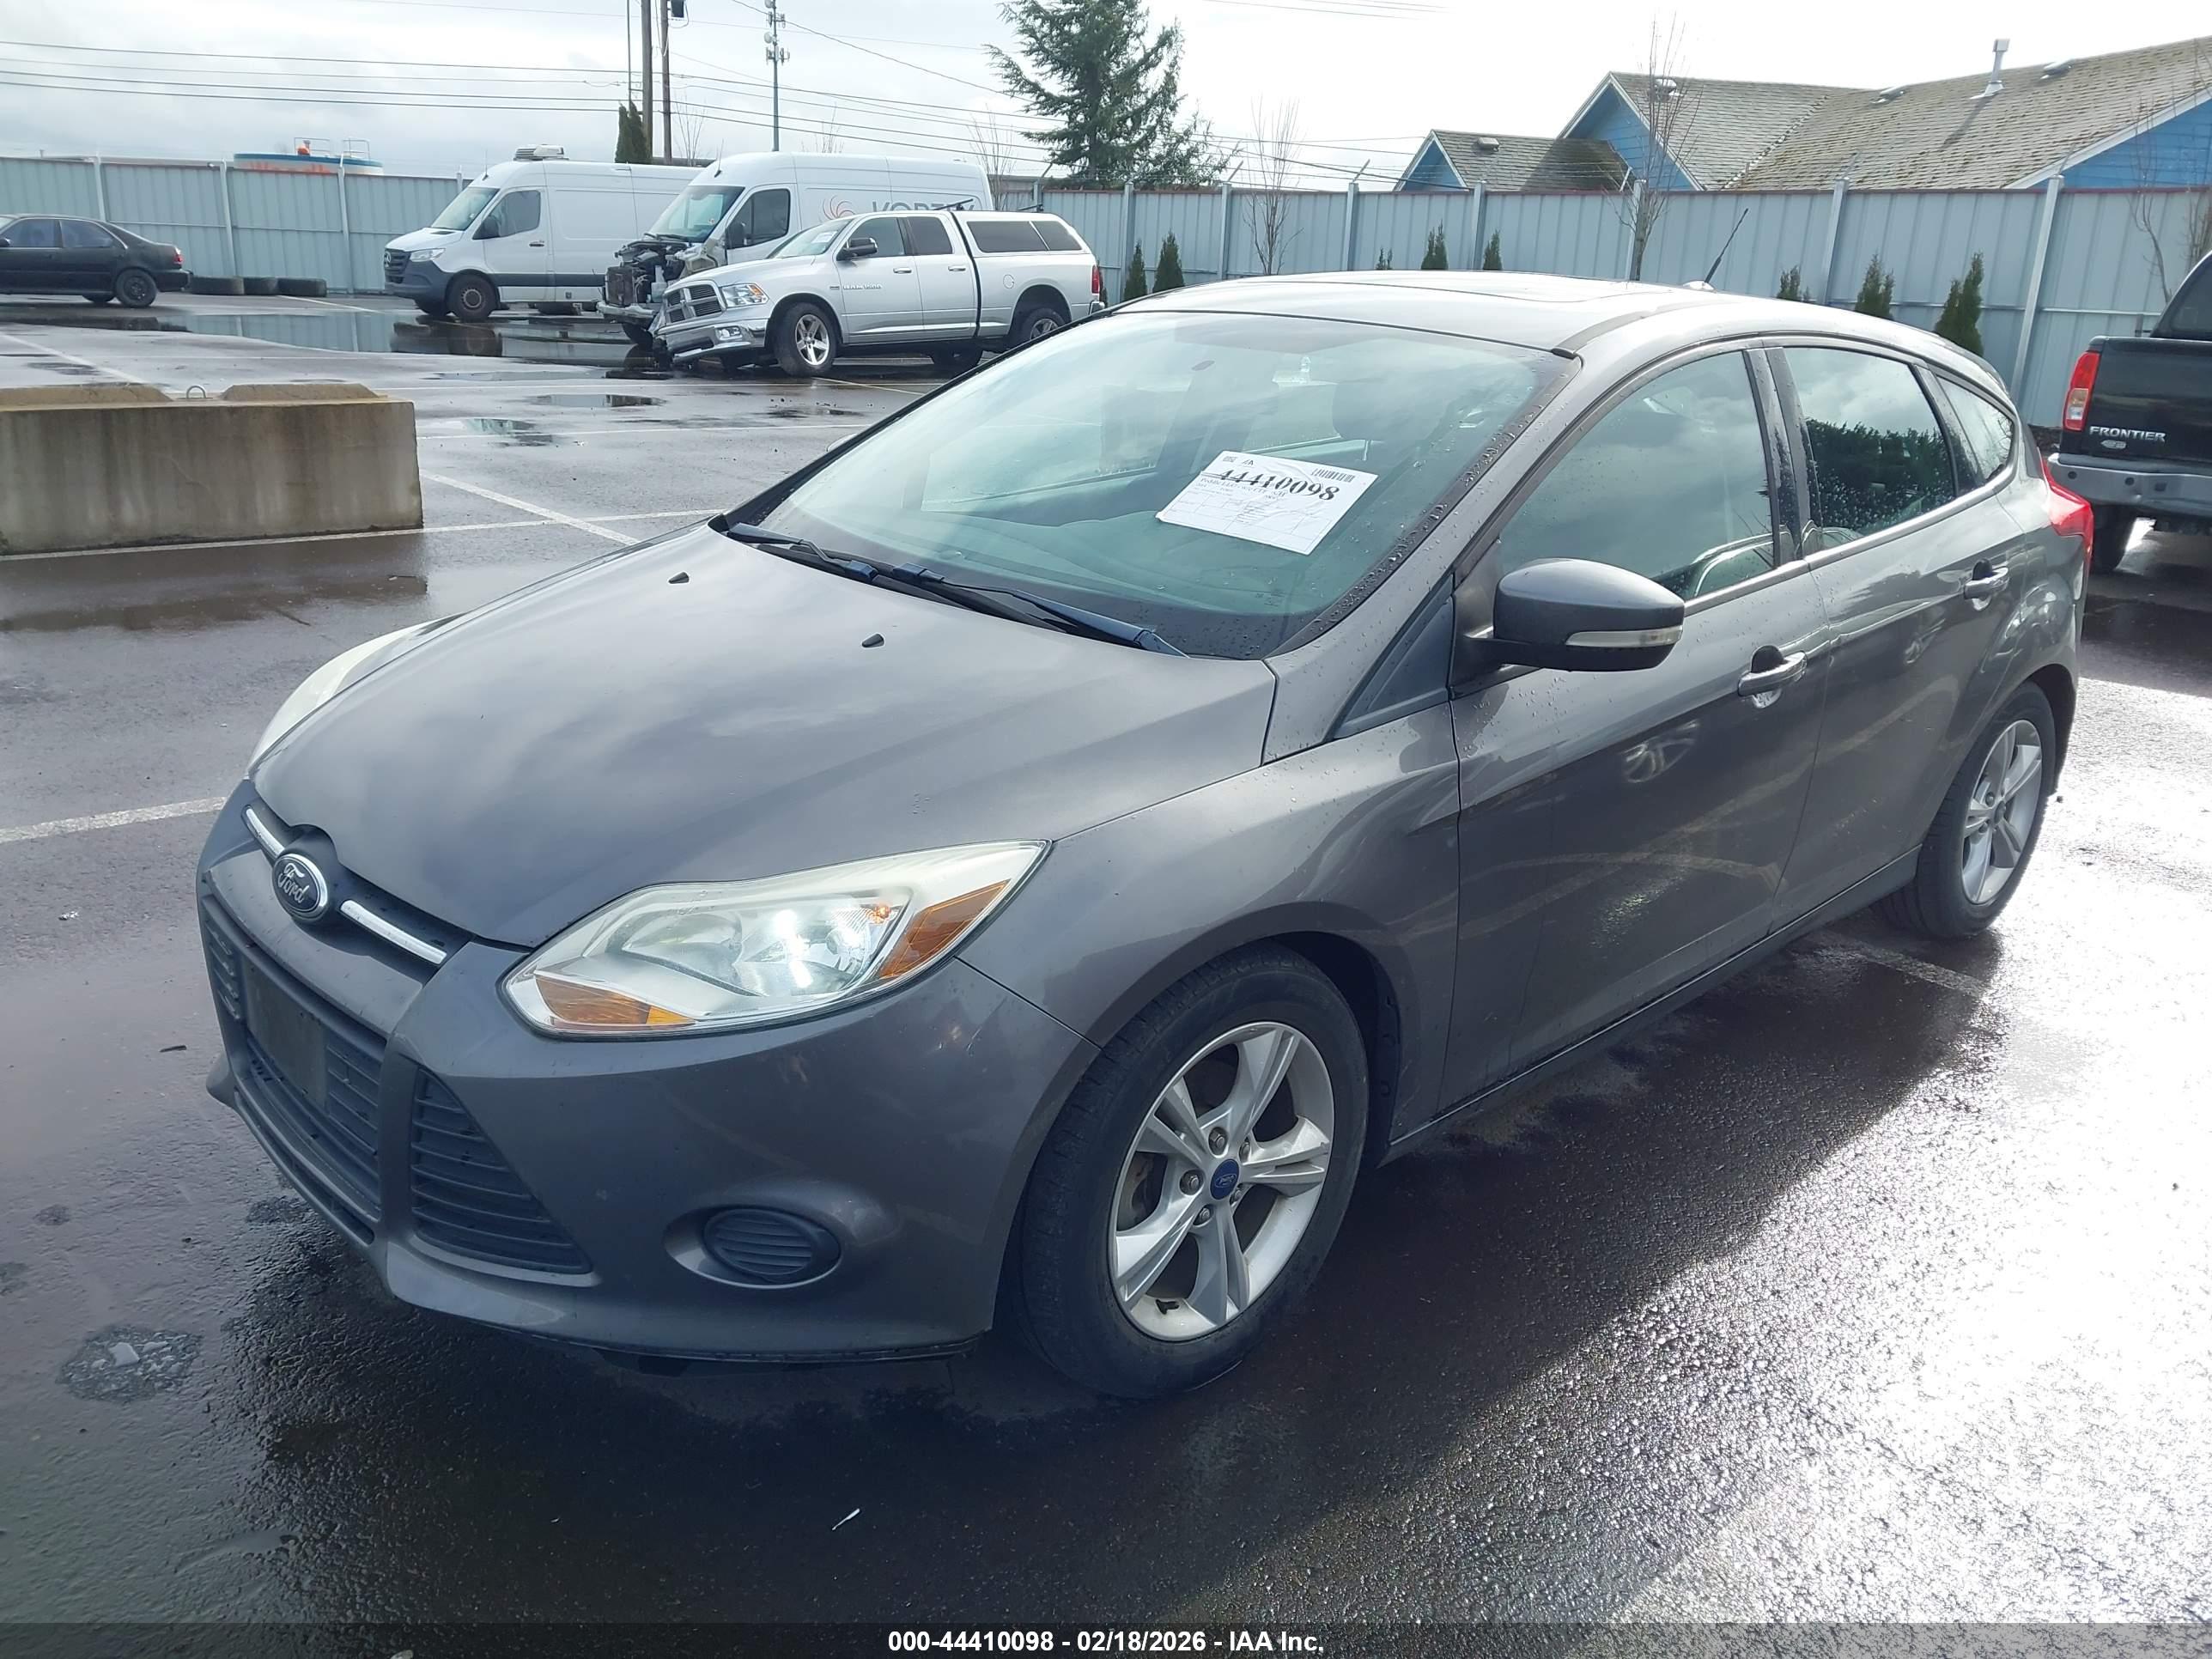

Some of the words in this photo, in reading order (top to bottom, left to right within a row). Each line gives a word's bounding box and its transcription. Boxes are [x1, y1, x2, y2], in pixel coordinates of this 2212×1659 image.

[2088, 425, 2166, 442] FRONTIER
[1219, 469, 1340, 501] 44410098
[277, 862, 310, 904] Ford
